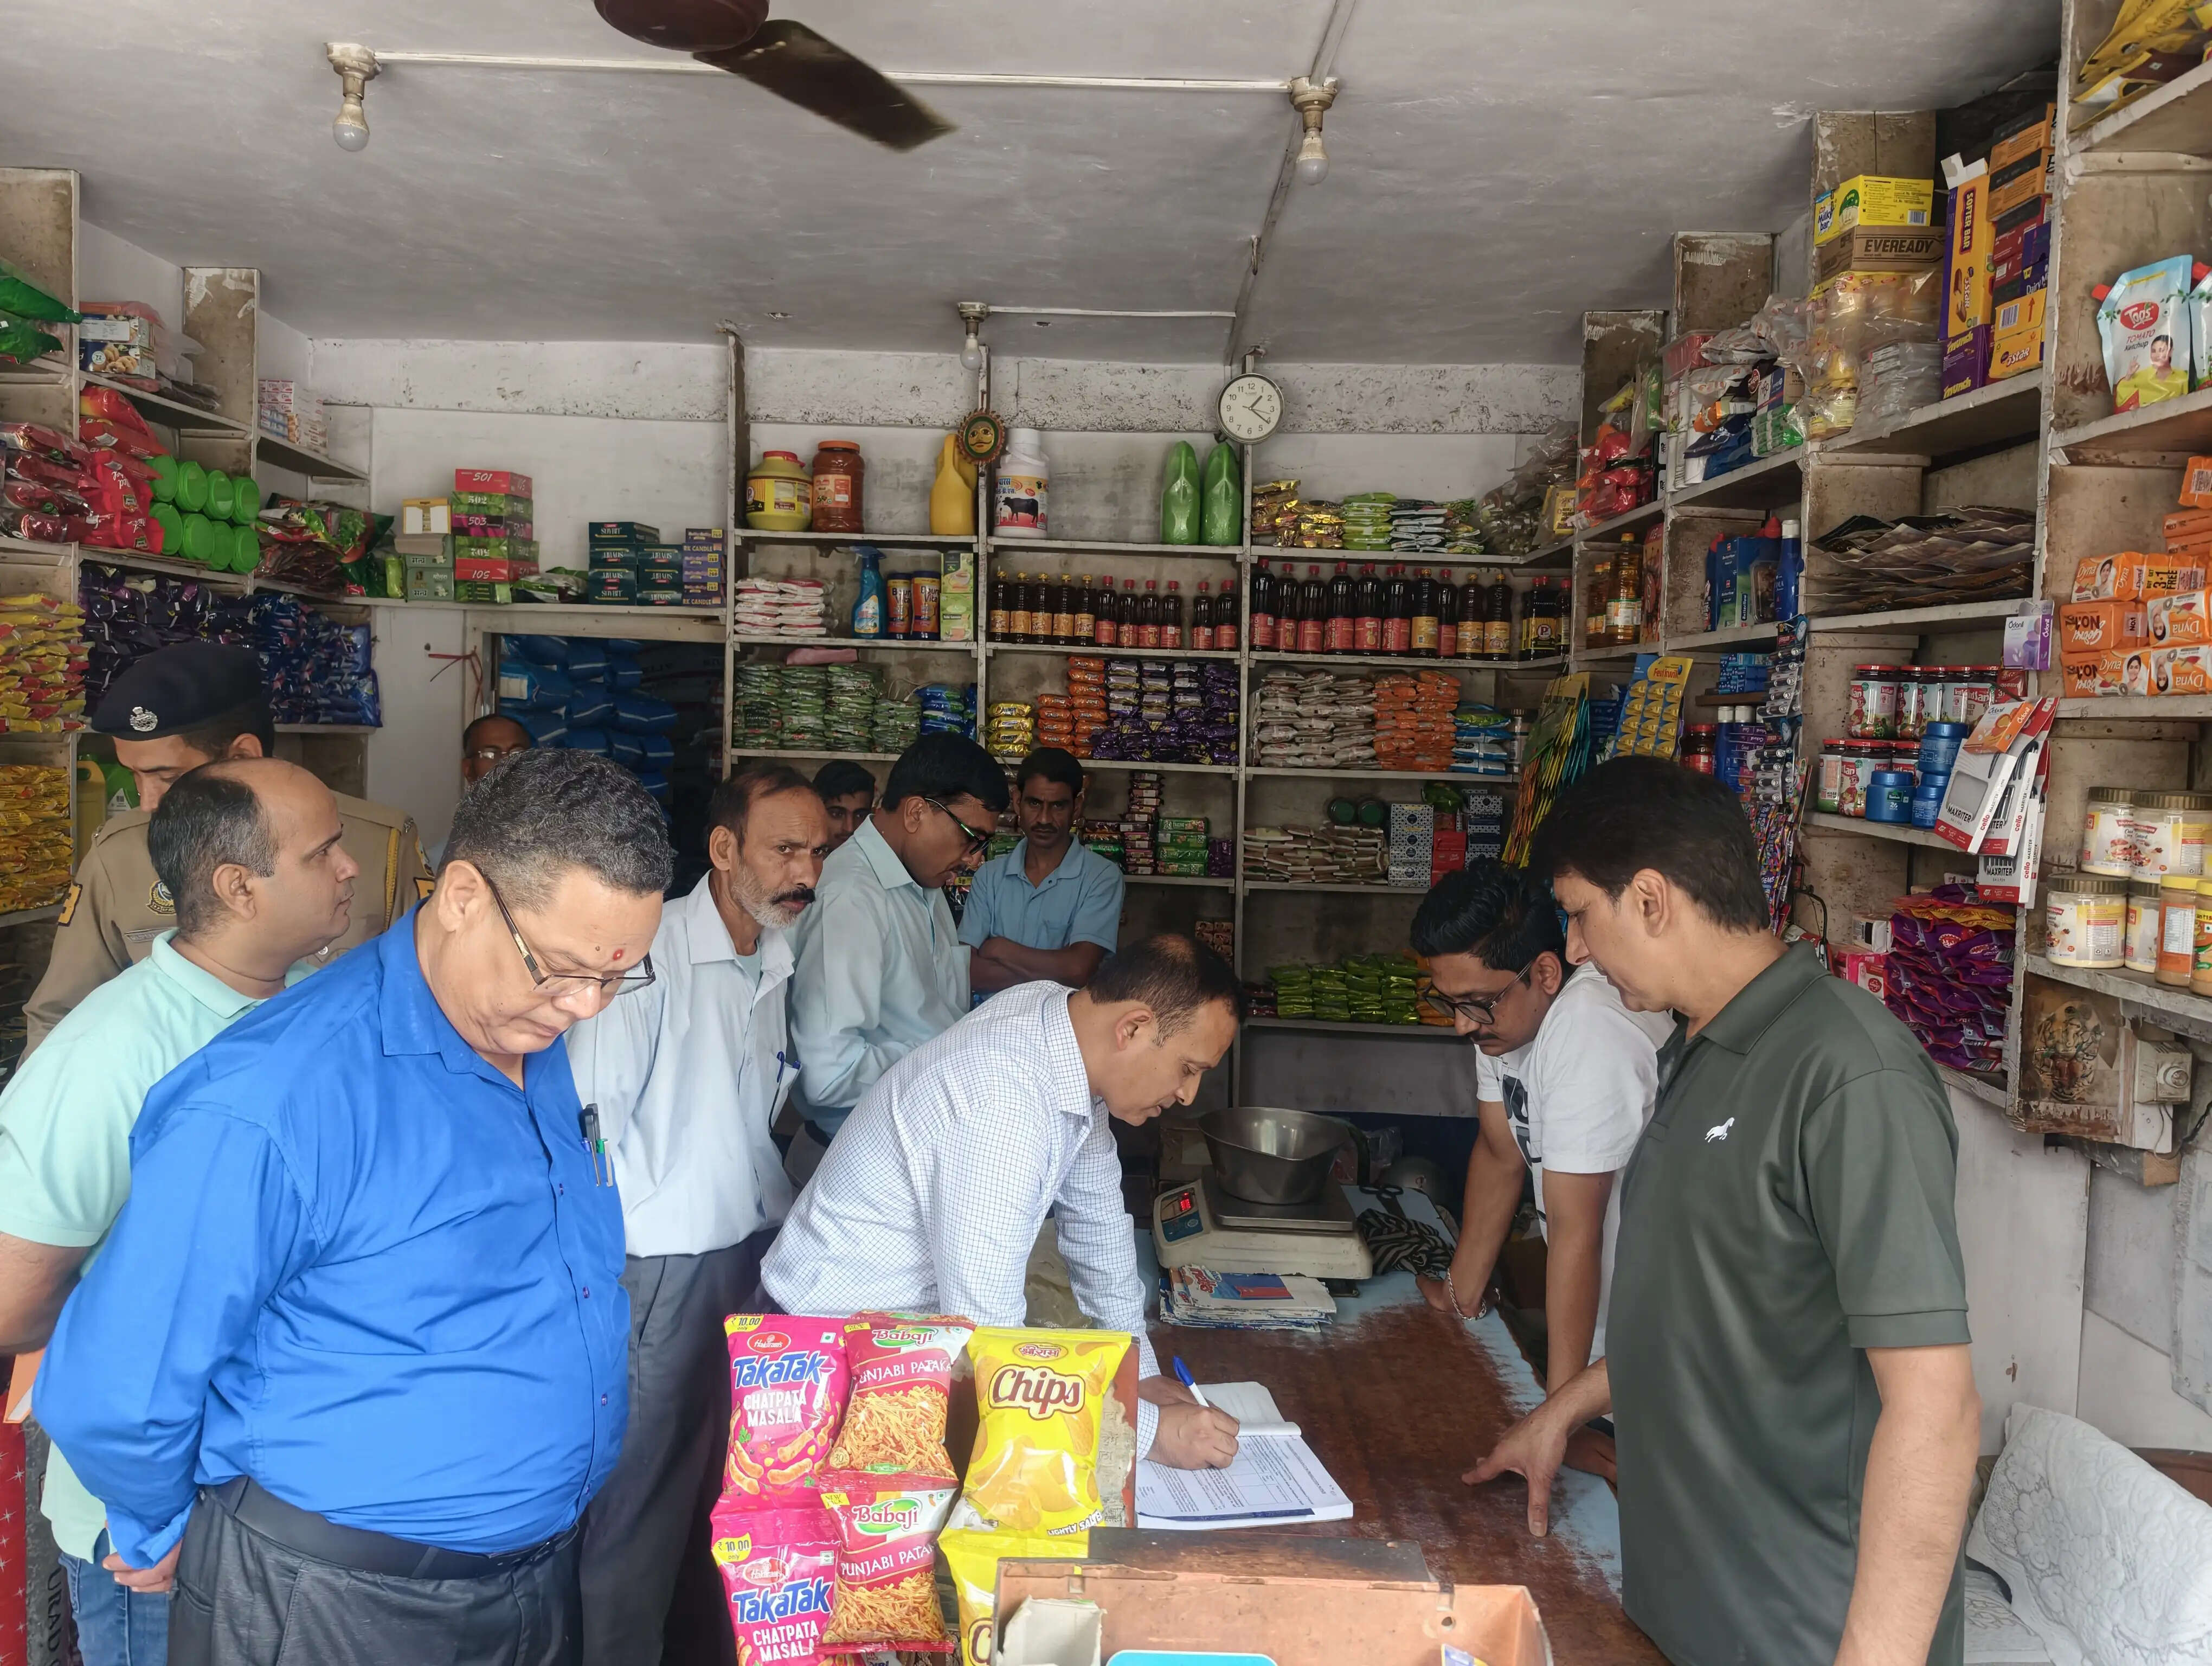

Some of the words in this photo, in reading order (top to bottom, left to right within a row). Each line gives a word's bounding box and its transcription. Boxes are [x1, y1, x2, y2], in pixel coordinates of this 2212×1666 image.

[1964, 192, 1973, 228] SOFTER
[1864, 239, 1933, 253] EVEREADY
[2127, 329, 2155, 344] TOMATO
[2124, 341, 2149, 351] Ketchup
[472, 472, 493, 482] 501
[468, 517, 487, 526] 503
[2078, 565, 2096, 578] Dyna
[2117, 567, 2129, 588] Dyna
[2166, 570, 2177, 590] FREE
[2008, 620, 2024, 629] Odonil
[2172, 617, 2200, 634] Dyna
[2099, 659, 2121, 674] Dyna
[2176, 670, 2204, 688] Dyna
[2017, 707, 2031, 724] Odonil
[1947, 805, 1972, 823] MAXRITER
[1980, 814, 1990, 831] cello
[1986, 867, 2012, 876] MAXRITER
[738, 1317, 760, 1326] 10.00
[872, 1329, 934, 1346] Babaji
[911, 1359, 951, 1374] PATAKA
[743, 1389, 807, 1410] CHATPATA
[992, 1368, 1081, 1415] Chips
[748, 1409, 802, 1427] MASALA
[852, 1502, 918, 1529] Babaji
[1047, 1523, 1077, 1536] LIGHTLY
[725, 1540, 749, 1552] 10.00
[841, 1555, 894, 1577] PUNJABI
[753, 1620, 820, 1646] CHATPATA
